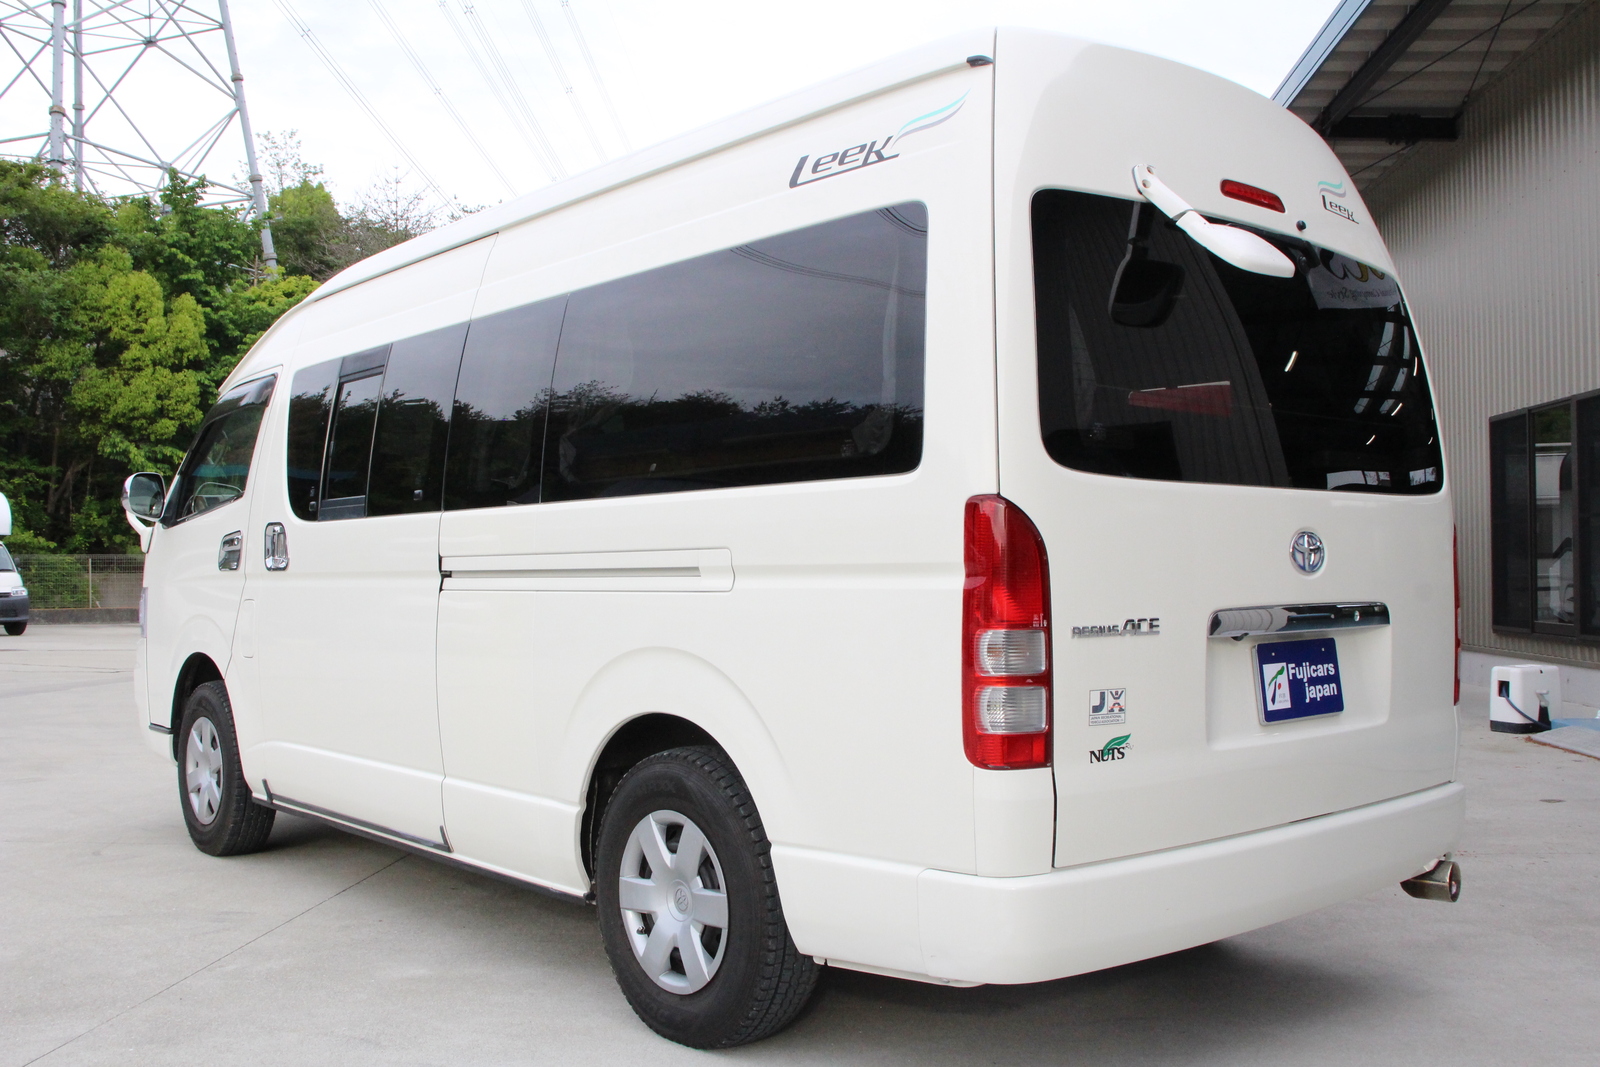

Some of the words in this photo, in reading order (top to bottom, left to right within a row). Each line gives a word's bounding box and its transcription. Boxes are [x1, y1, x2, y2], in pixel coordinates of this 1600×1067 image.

[1120, 617, 1160, 637] ACE
[1287, 661, 1336, 683] Fujicars
[1304, 682, 1338, 704] japan
[1089, 746, 1126, 764] NUTS
